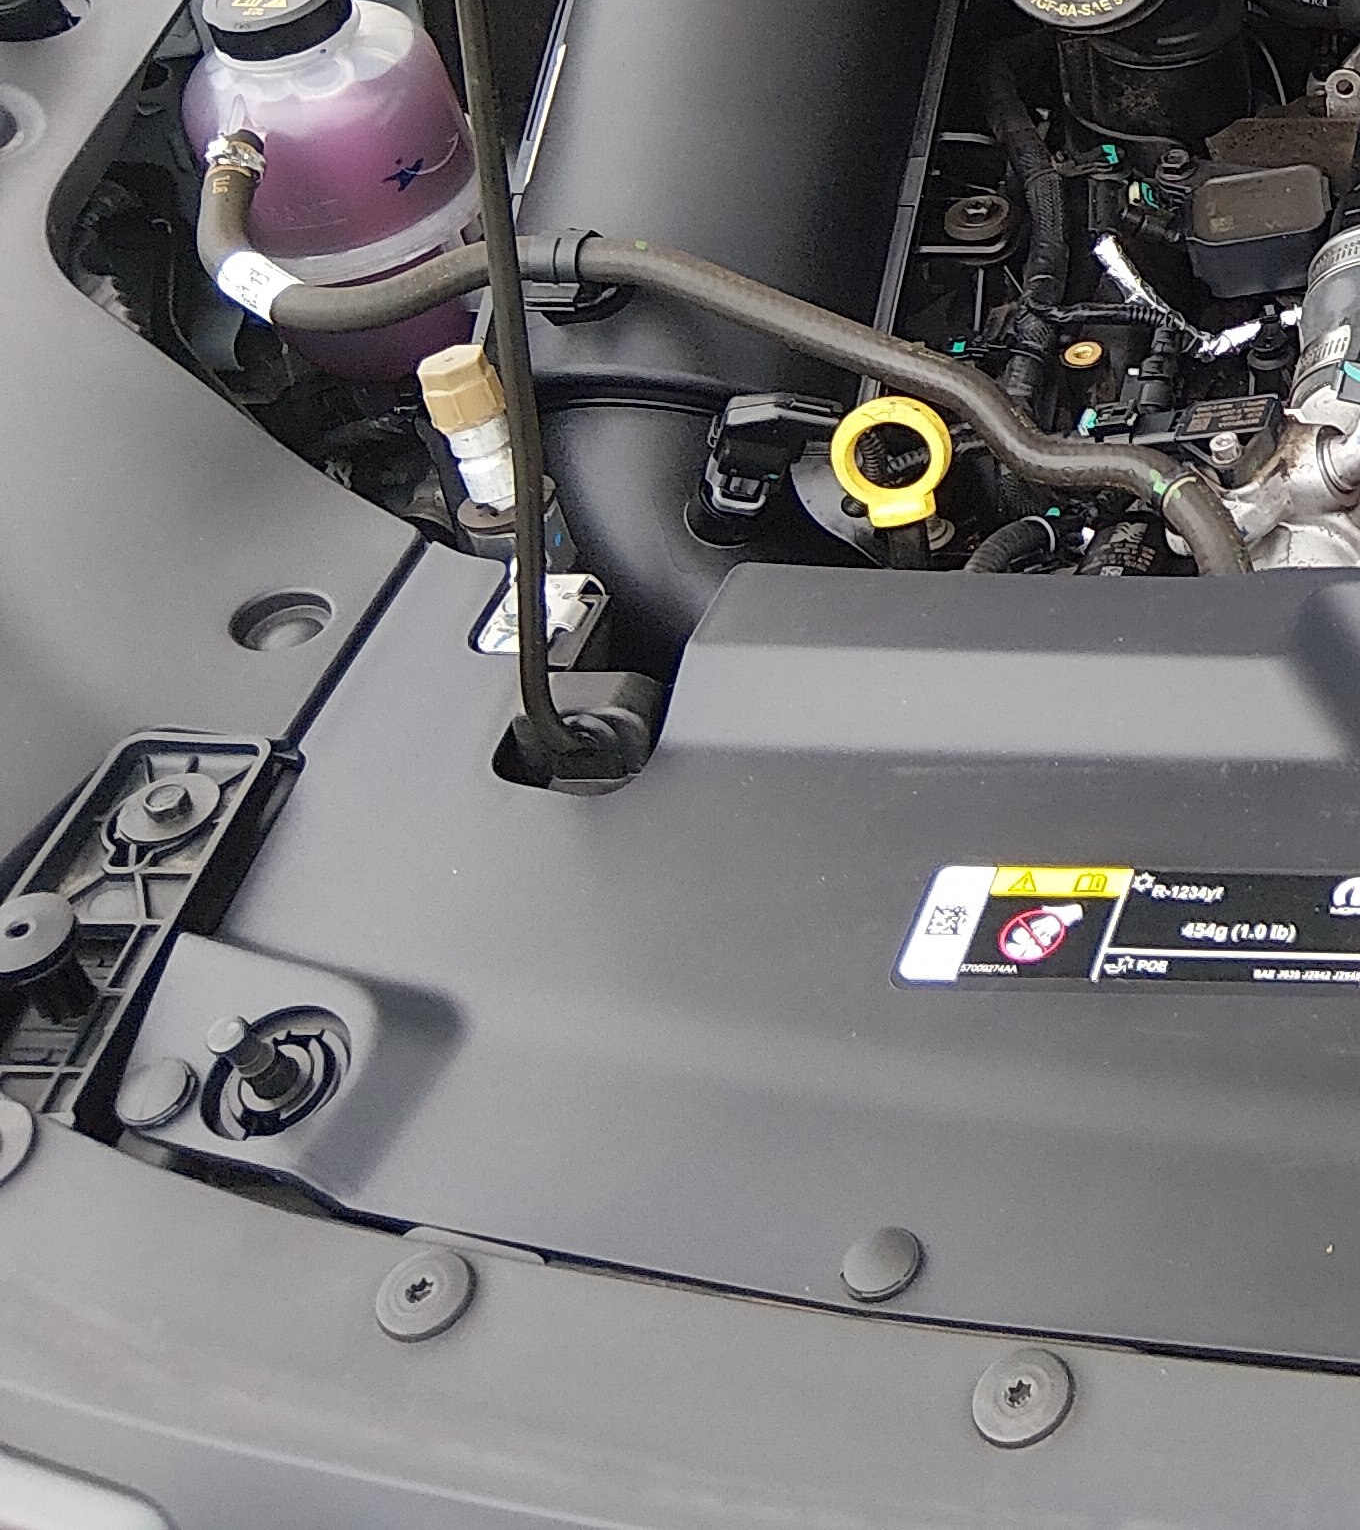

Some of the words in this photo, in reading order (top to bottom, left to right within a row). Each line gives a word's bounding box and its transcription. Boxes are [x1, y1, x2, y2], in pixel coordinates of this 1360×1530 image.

[1151, 884, 1225, 904] R-1234yf
[1181, 923, 1229, 943] 454g
[1230, 923, 1268, 943] (1.0
[1269, 923, 1297, 943] lb)
